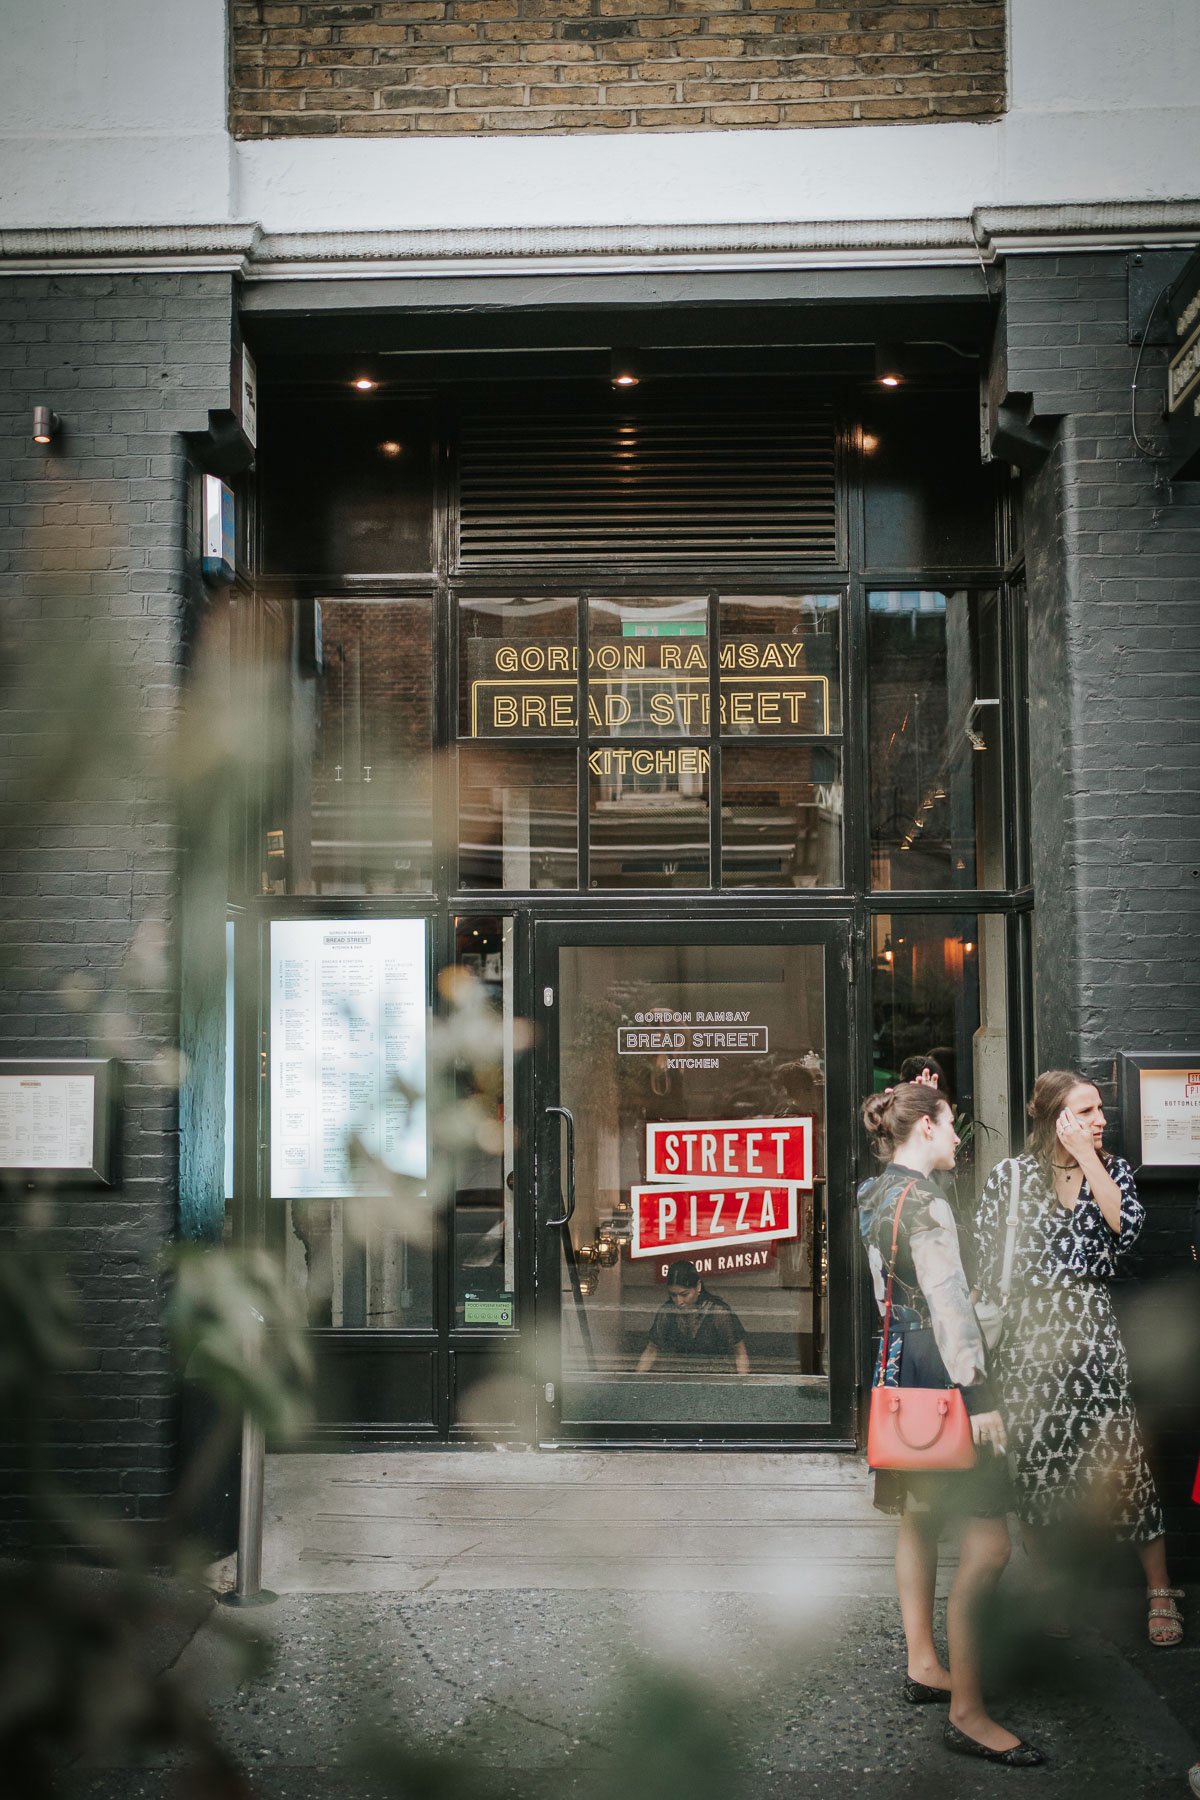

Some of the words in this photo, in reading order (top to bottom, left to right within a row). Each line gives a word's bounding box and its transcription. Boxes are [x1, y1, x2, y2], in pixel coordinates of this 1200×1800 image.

[660, 643, 803, 669] RAMSAY
[493, 694, 632, 727] BREAD
[650, 691, 807, 725] STREET
[634, 1011, 692, 1023] GORDON
[695, 1011, 751, 1022] RAMSAY
[626, 1033, 686, 1047] BREAD
[692, 1032, 759, 1047] STREET
[666, 1058, 720, 1069] KITCHEN
[665, 1132, 790, 1174] STREET
[658, 1190, 776, 1241] PIZZA
[661, 1258, 712, 1277] GON
[718, 1251, 769, 1270] RAMSAY
